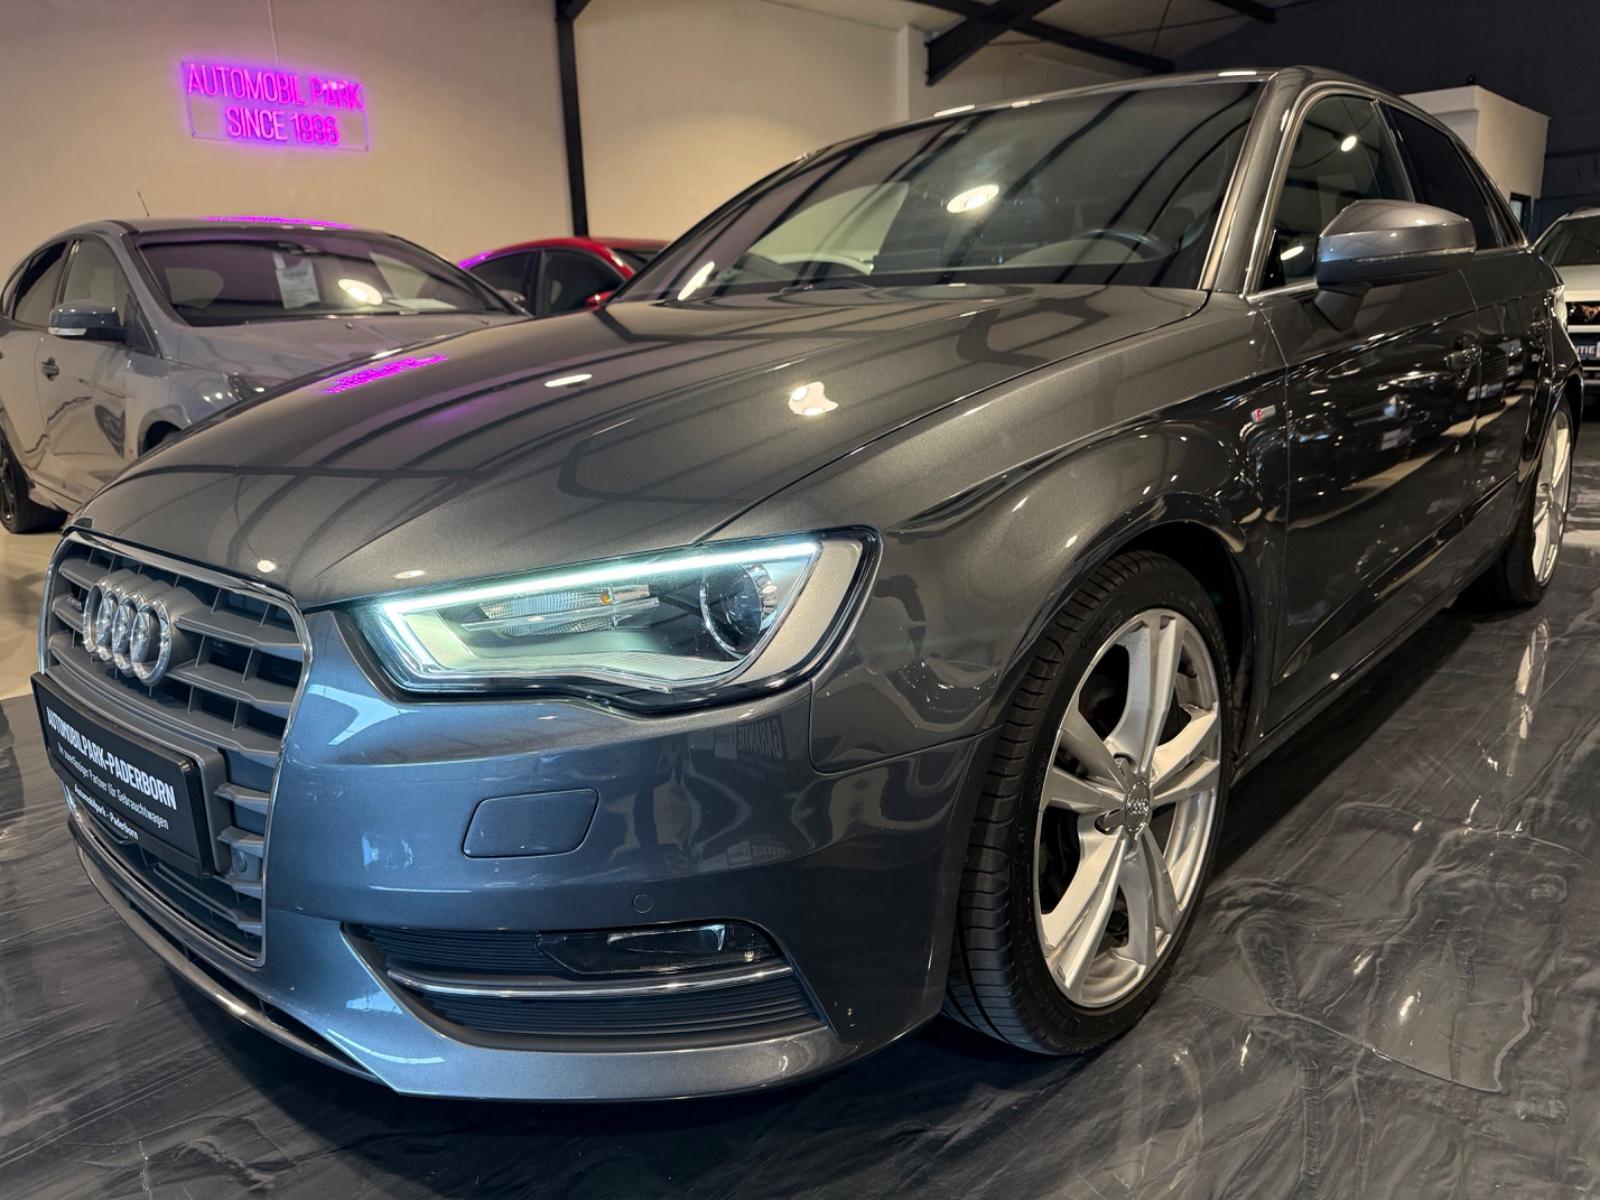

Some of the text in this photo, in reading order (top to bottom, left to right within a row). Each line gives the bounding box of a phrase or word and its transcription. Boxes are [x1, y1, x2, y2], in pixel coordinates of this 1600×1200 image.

[187, 63, 365, 112] AUTOMOBIL PARK
[226, 106, 341, 145] SINCE 1996
